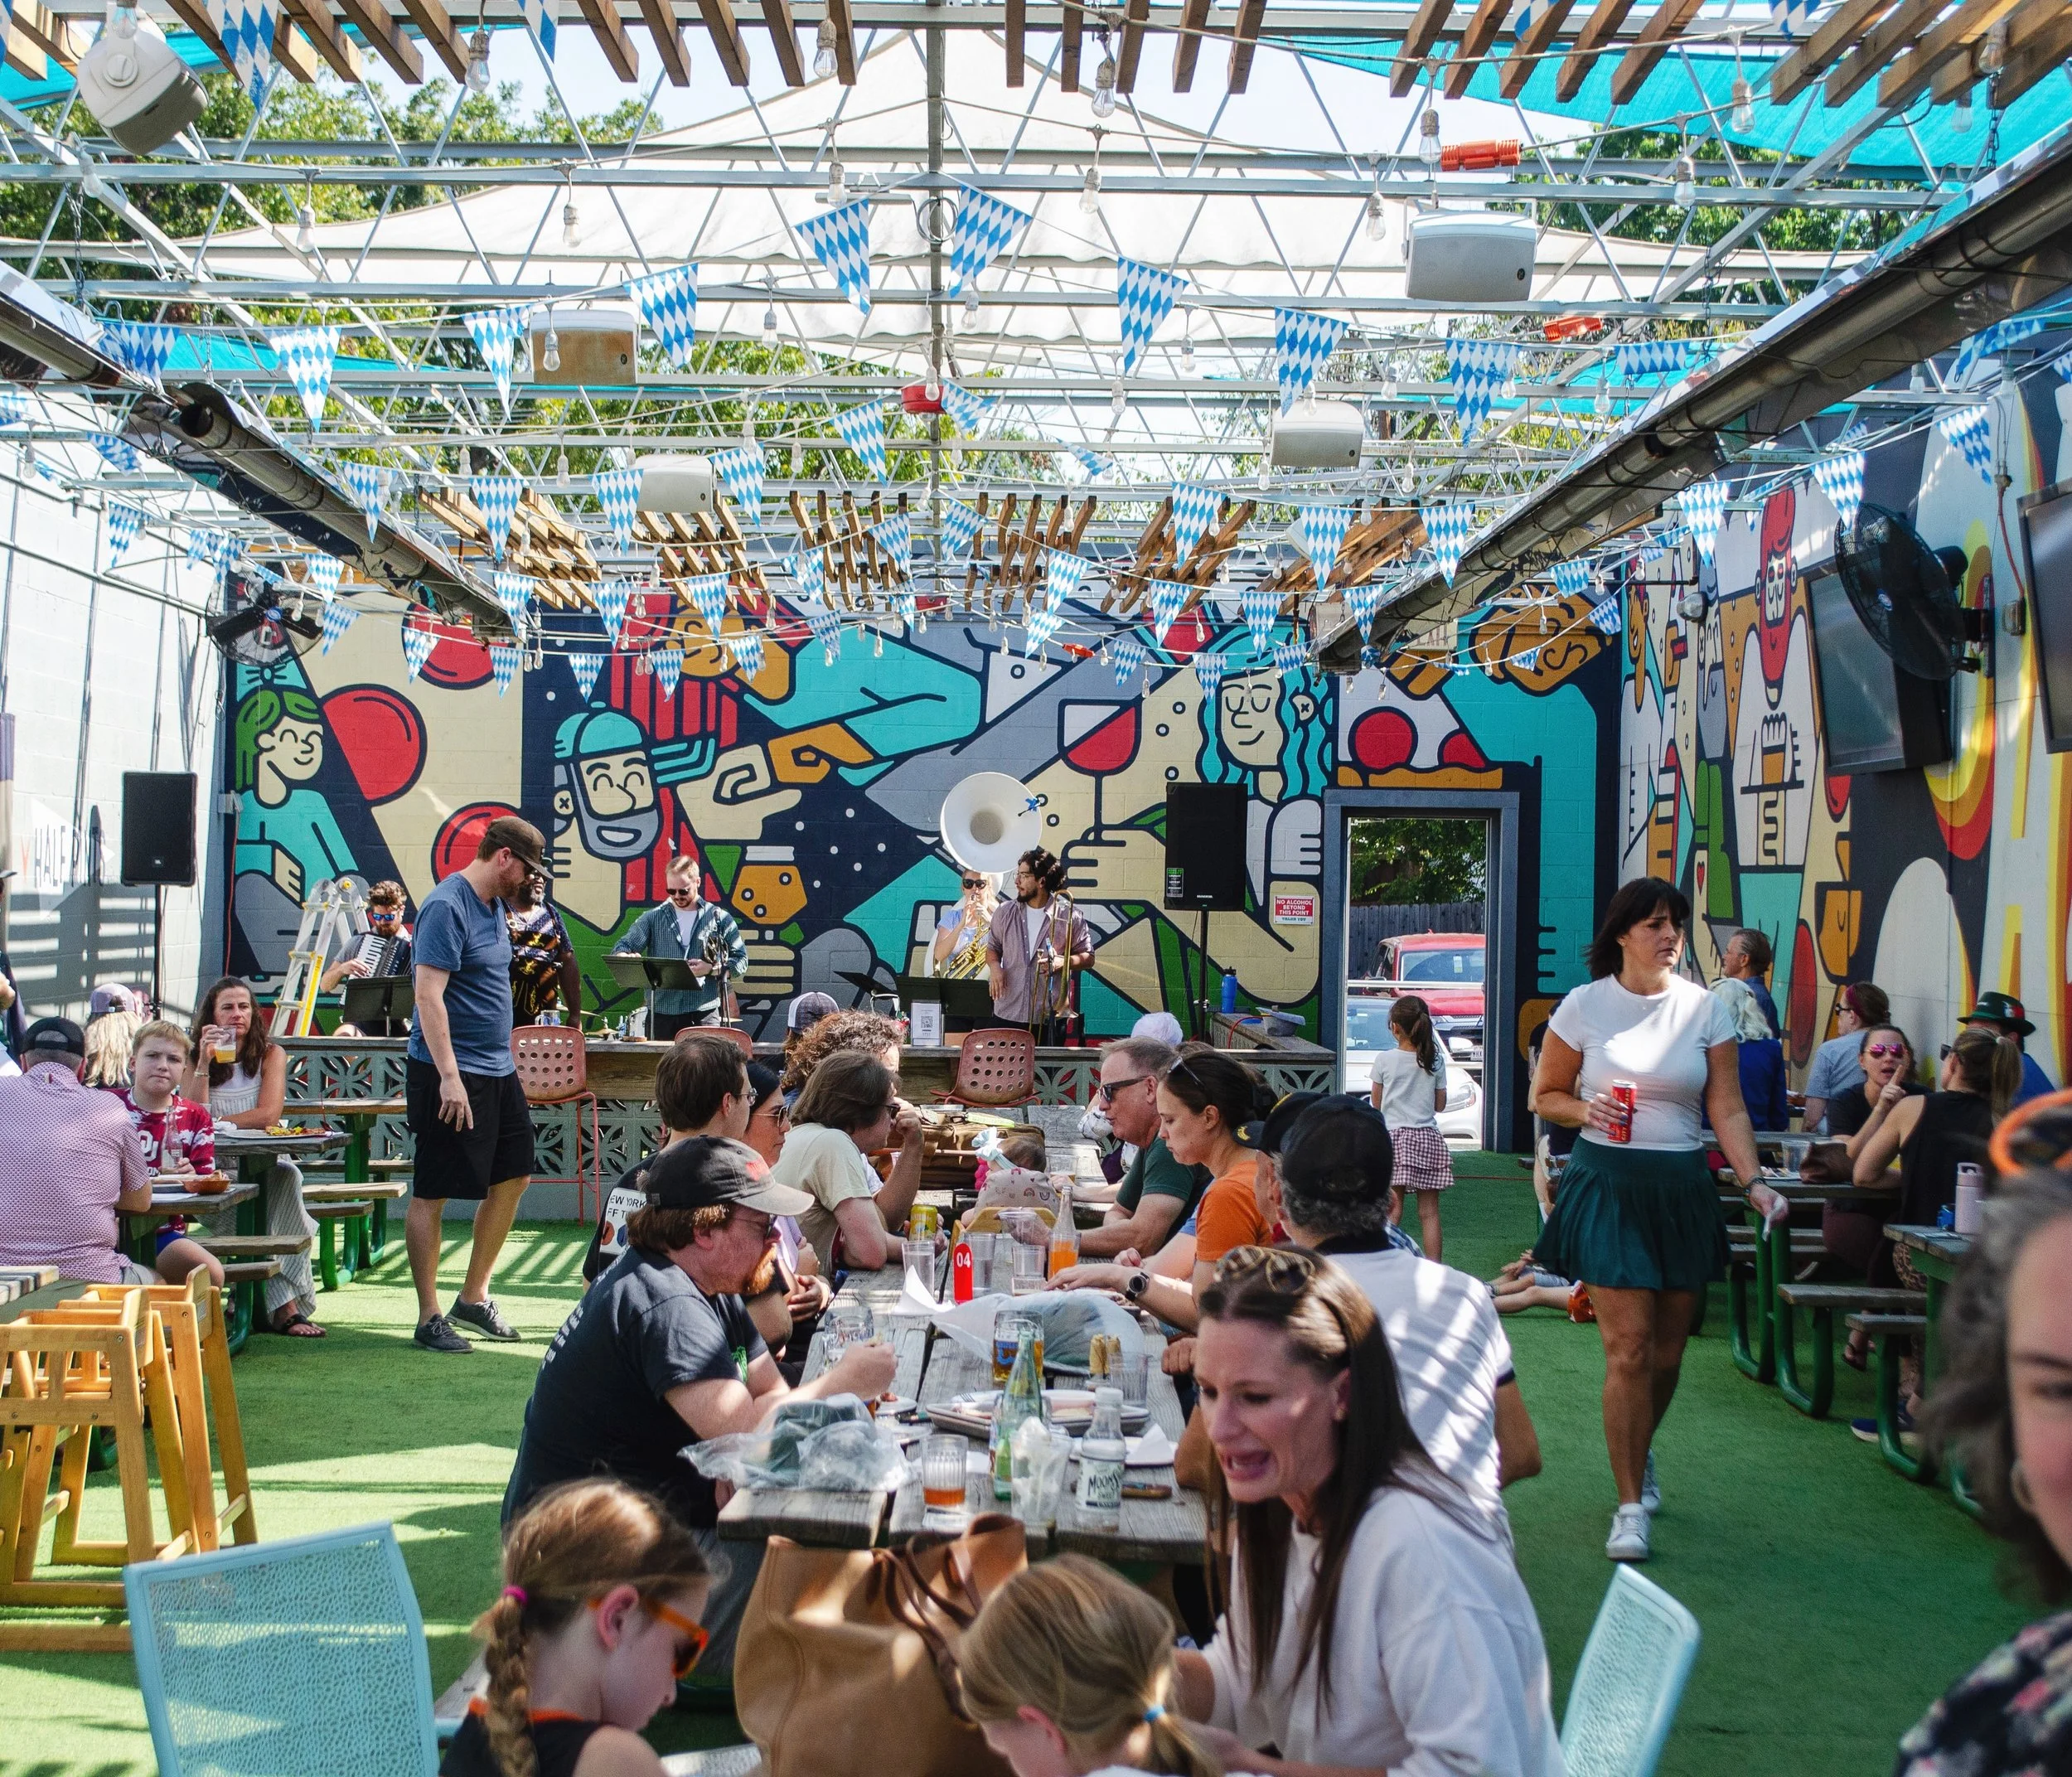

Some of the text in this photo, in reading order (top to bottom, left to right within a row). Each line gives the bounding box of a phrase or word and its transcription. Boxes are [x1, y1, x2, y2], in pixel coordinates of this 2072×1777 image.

[34, 824, 66, 888] HALF
[609, 1194, 647, 1208] EW YORK
[608, 1208, 619, 1218] FF
[956, 1252, 971, 1268] 04
